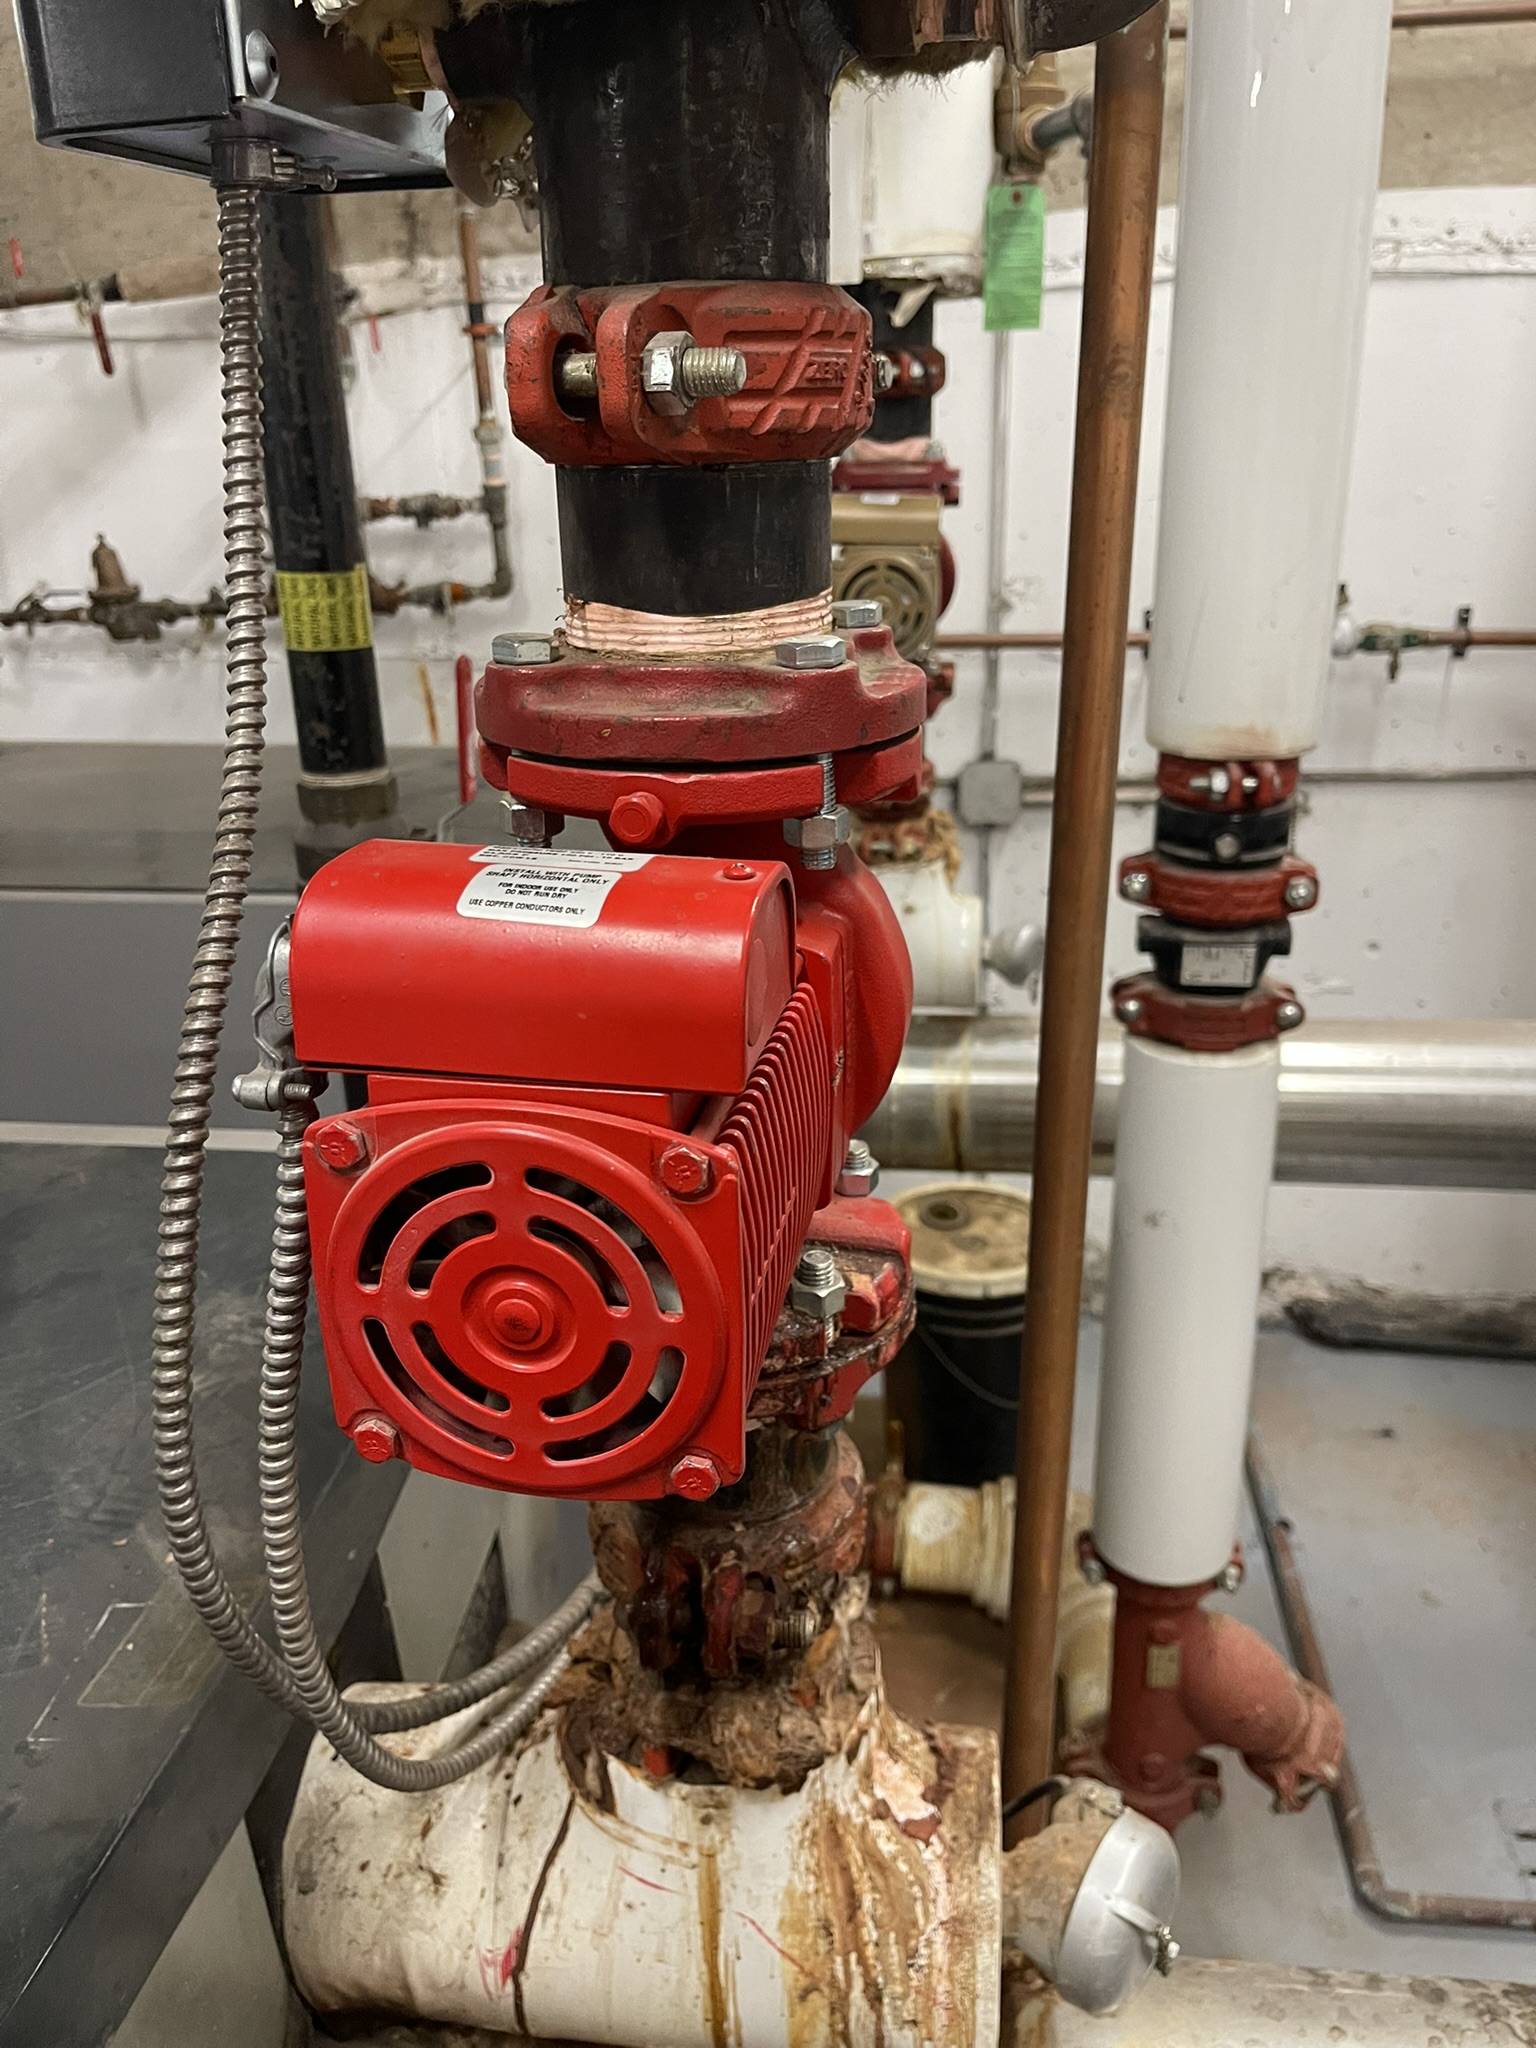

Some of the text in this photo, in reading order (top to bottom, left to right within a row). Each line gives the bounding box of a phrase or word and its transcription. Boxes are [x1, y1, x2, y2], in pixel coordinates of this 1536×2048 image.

[519, 873, 579, 883] HORIZONTAL
[514, 883, 542, 891] INDOOR
[544, 885, 559, 893] USE
[559, 886, 579, 894] ONLY
[534, 890, 550, 898] RUN
[551, 892, 568, 900] DRY
[468, 898, 586, 916] USE COPPER CONDUCTORS ONLY
